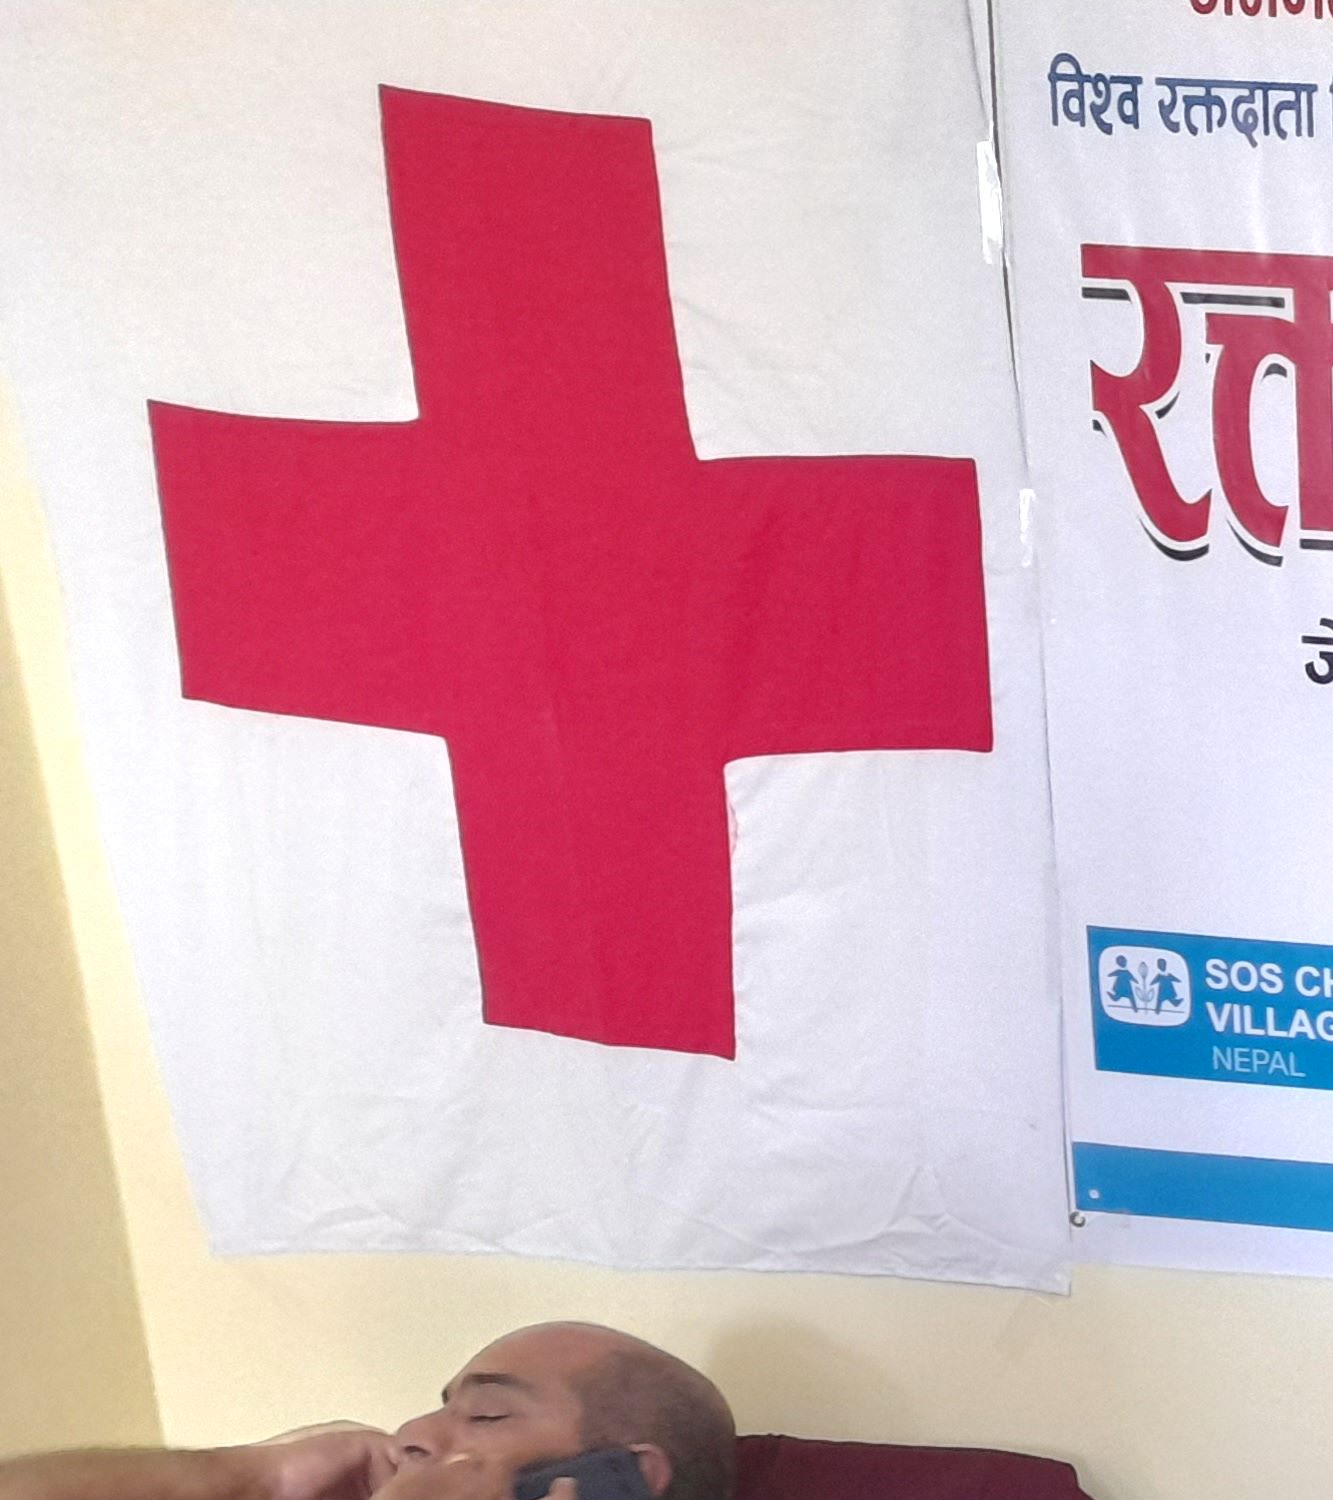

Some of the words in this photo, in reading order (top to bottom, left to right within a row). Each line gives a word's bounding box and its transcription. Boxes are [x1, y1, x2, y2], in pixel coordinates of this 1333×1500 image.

[1047, 52, 1144, 136] विश्व
[1154, 76, 1319, 149] रक्तदाता
[1205, 958, 1284, 994] SOS
[1212, 1045, 1307, 1078] NEPAL
